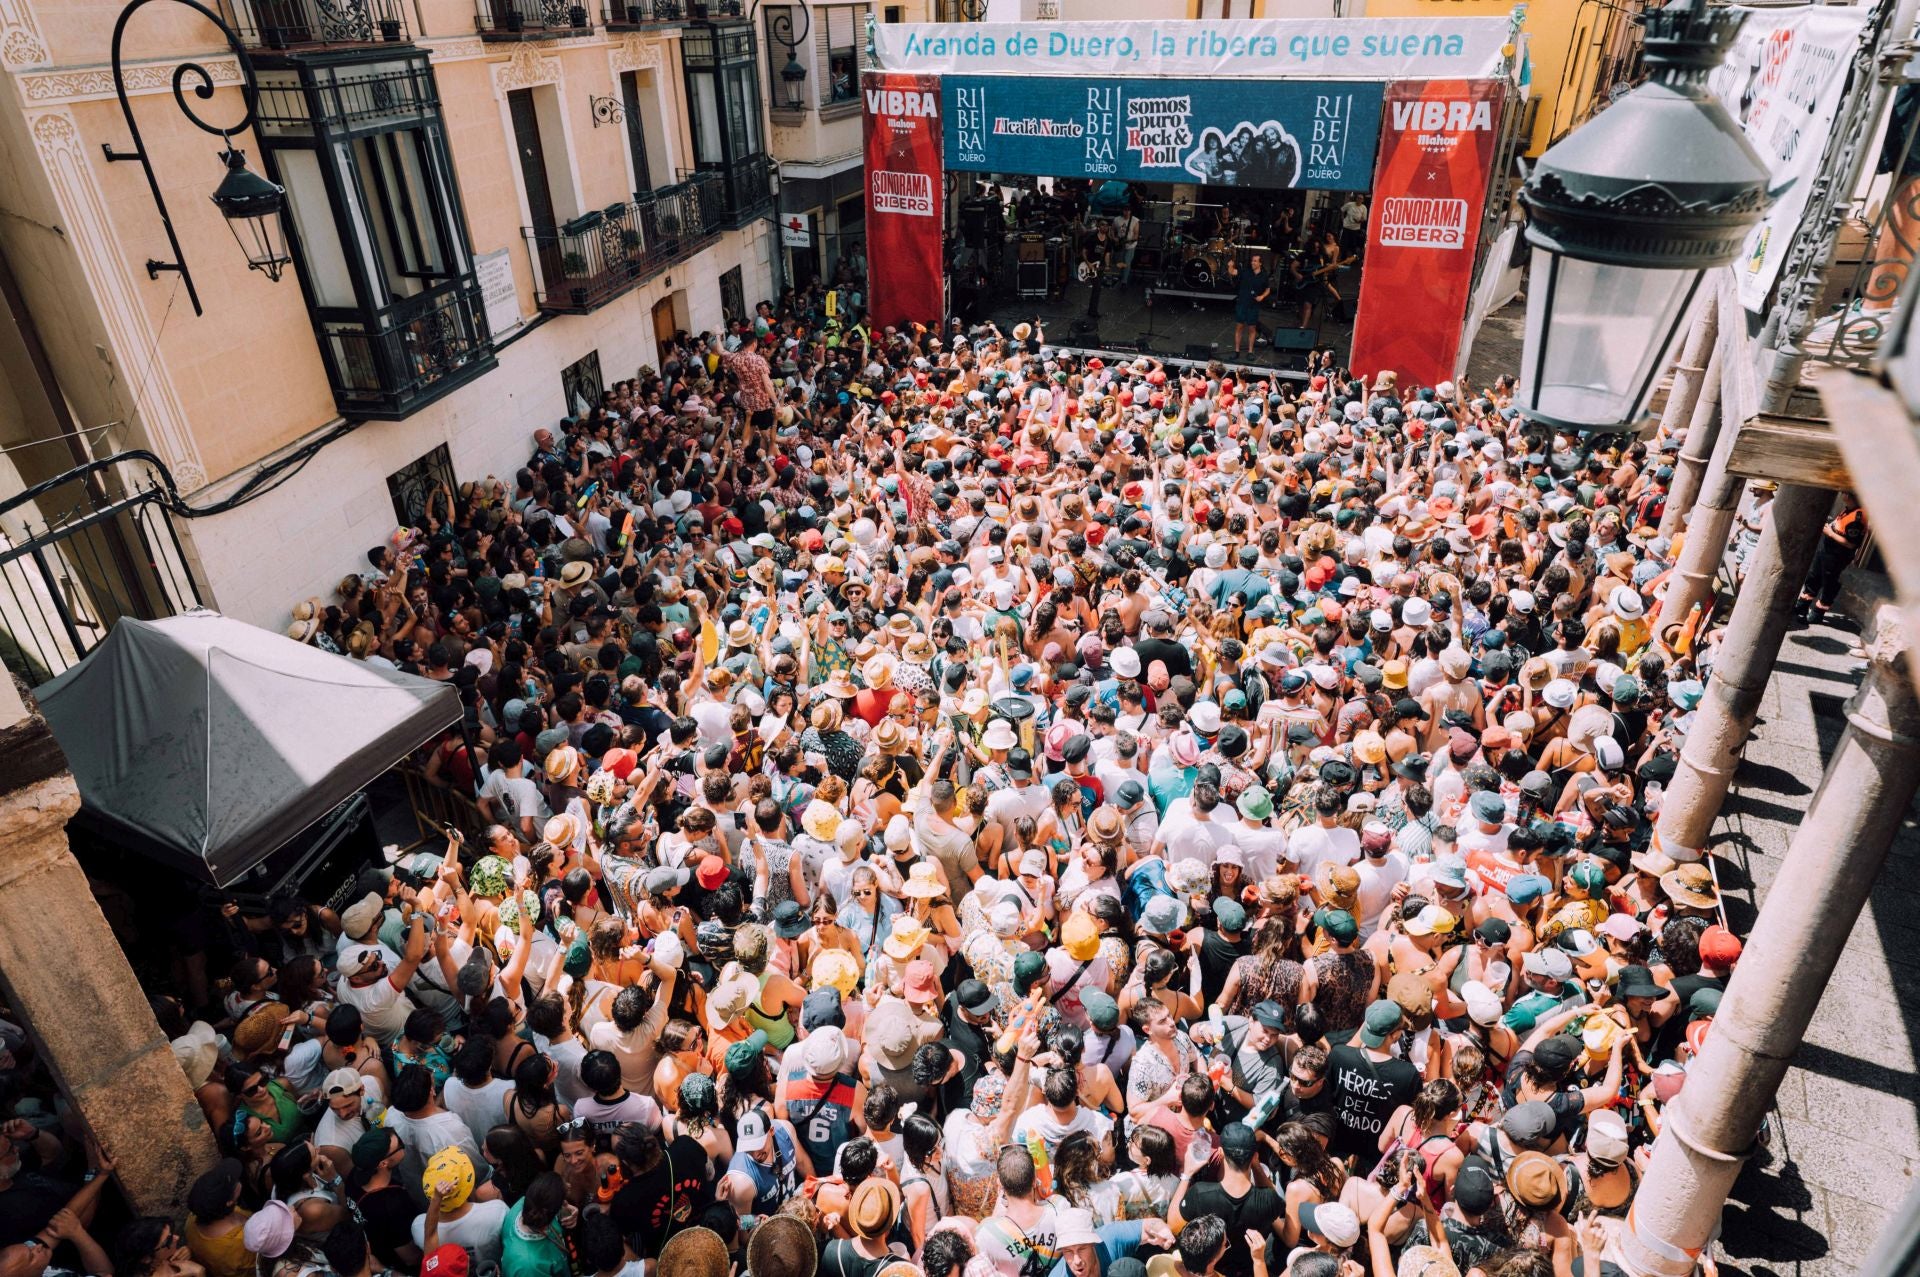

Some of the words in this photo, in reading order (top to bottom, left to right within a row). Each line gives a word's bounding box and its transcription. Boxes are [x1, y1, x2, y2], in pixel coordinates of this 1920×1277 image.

[904, 32, 996, 57] Aranda
[1005, 31, 1039, 57] de
[1048, 31, 1139, 61] Duero,
[1152, 30, 1175, 56] la
[1186, 30, 1278, 57] ribera
[1289, 34, 1350, 61] que
[1361, 33, 1464, 57] suena
[866, 90, 938, 118] VIBRA
[1129, 99, 1188, 115] somos
[1139, 115, 1182, 131] puro
[1392, 101, 1492, 131] VIBRA
[1040, 120, 1081, 137] Norte
[1129, 130, 1172, 148] Rock
[1173, 128, 1188, 146] &
[958, 152, 986, 163] DUERO
[1143, 147, 1177, 164] Roll
[1084, 162, 1117, 174] DUERO
[1307, 169, 1341, 180] DUERO
[873, 171, 929, 198] SONORAMA
[874, 195, 929, 211] RIBERA
[1384, 199, 1463, 227] SONORAMA
[1381, 226, 1460, 244] RIBERA
[1345, 1095, 1376, 1115] DEL
[808, 1117, 830, 1143] 6
